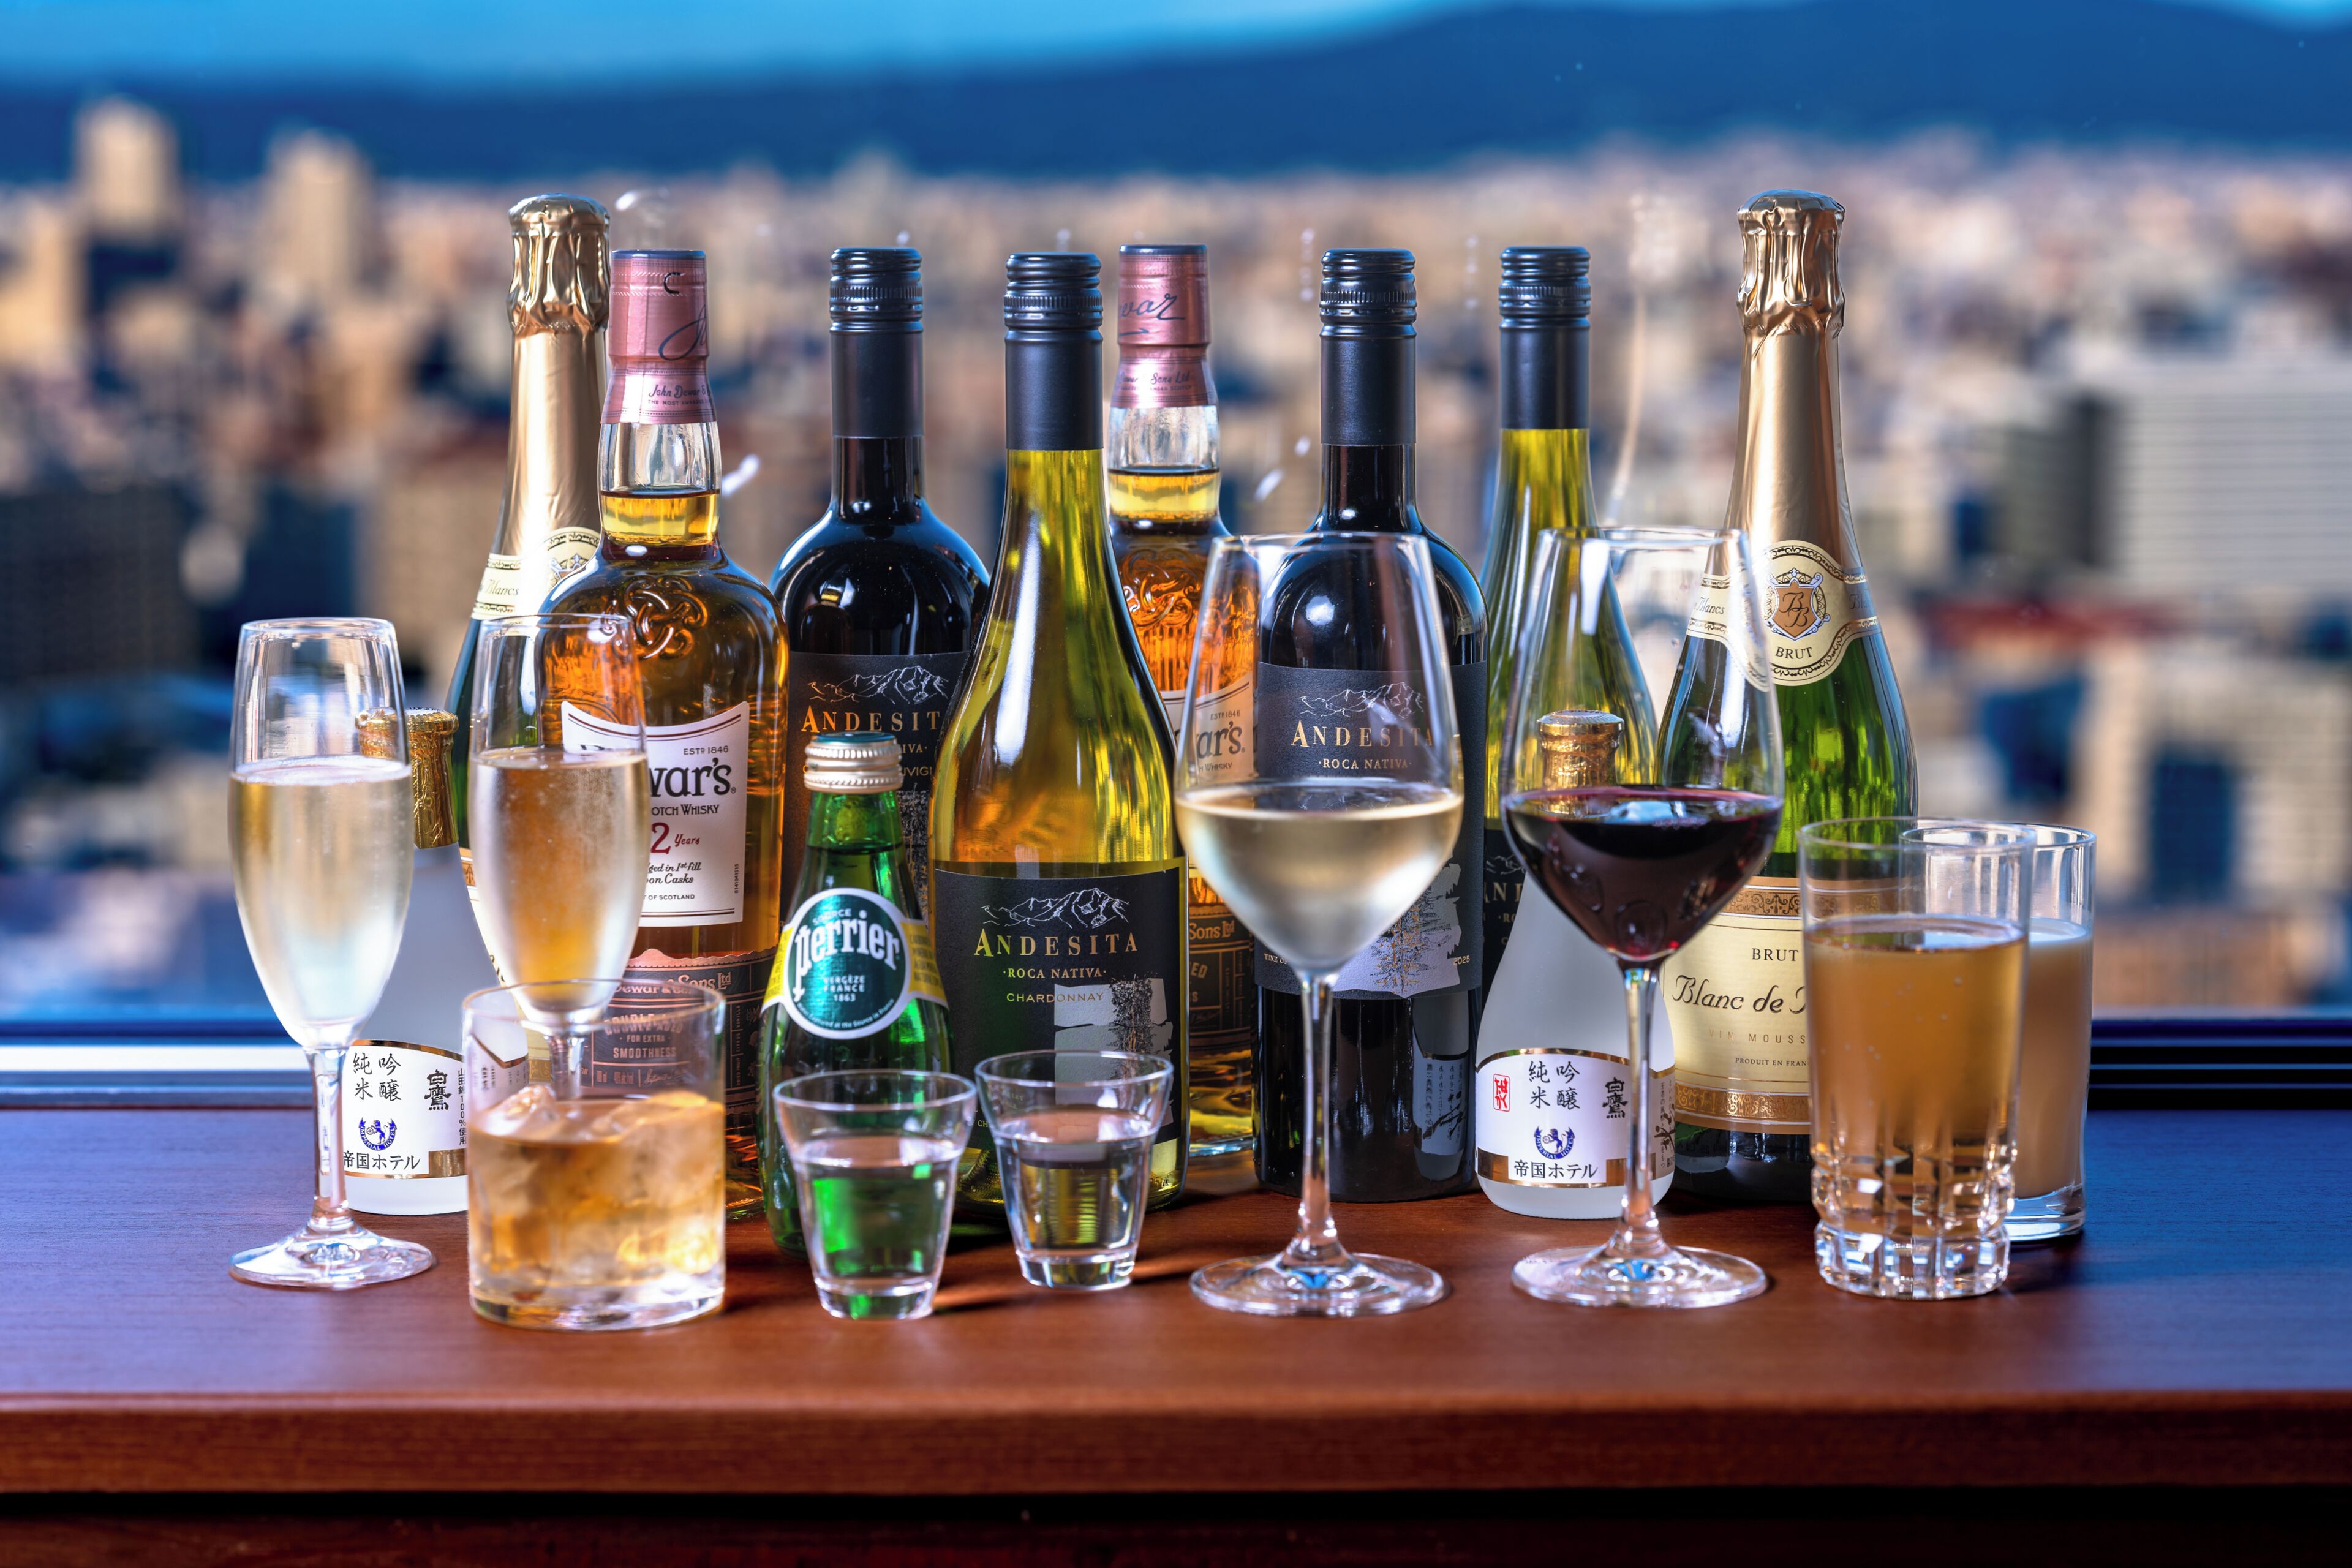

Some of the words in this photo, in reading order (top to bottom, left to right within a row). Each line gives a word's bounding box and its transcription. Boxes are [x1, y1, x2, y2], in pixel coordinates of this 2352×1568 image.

[649, 384, 671, 397] John
[674, 385, 699, 398] Dewar
[1774, 647, 1812, 660] BRUT
[801, 706, 940, 733] ANDESIT
[1291, 720, 1434, 747] ANDESITA
[708, 745, 728, 754] 1846
[1323, 758, 1359, 769] ROCA
[1364, 758, 1408, 769] NATIVA
[651, 807, 678, 816] OTCH
[680, 804, 719, 815] WHISKY
[650, 822, 671, 854] 2
[674, 834, 700, 847] Years
[648, 862, 663, 873] ged
[676, 862, 687, 872] 1st
[687, 862, 701, 871] fill
[665, 873, 693, 884] Casks
[1189, 922, 1221, 940] Sons
[974, 928, 1137, 957] ANDESITA
[1453, 956, 1470, 965] 2025
[1752, 948, 1800, 962] BRUT
[1008, 968, 1045, 979] ROCA
[1051, 968, 1102, 979] NATIVA
[834, 993, 856, 1002] 1863
[1006, 993, 1104, 1003] CHARDONNAY
[1672, 974, 1744, 1011] Blanc
[1752, 984, 1784, 1014] de
[1709, 1029, 1734, 1040] VIN
[1749, 1033, 1806, 1044] MOUSS
[613, 1047, 676, 1058] SMOOTHNESS
[360, 1126, 381, 1151] IMPERIAL
[383, 1126, 396, 1148] HOTEL
[1536, 1134, 1558, 1159] IMPERIAL
[1561, 1135, 1575, 1158] HOTEL
[344, 1150, 421, 1170] 帝国ホテル
[1514, 1159, 1599, 1180] 帝国ホテル
